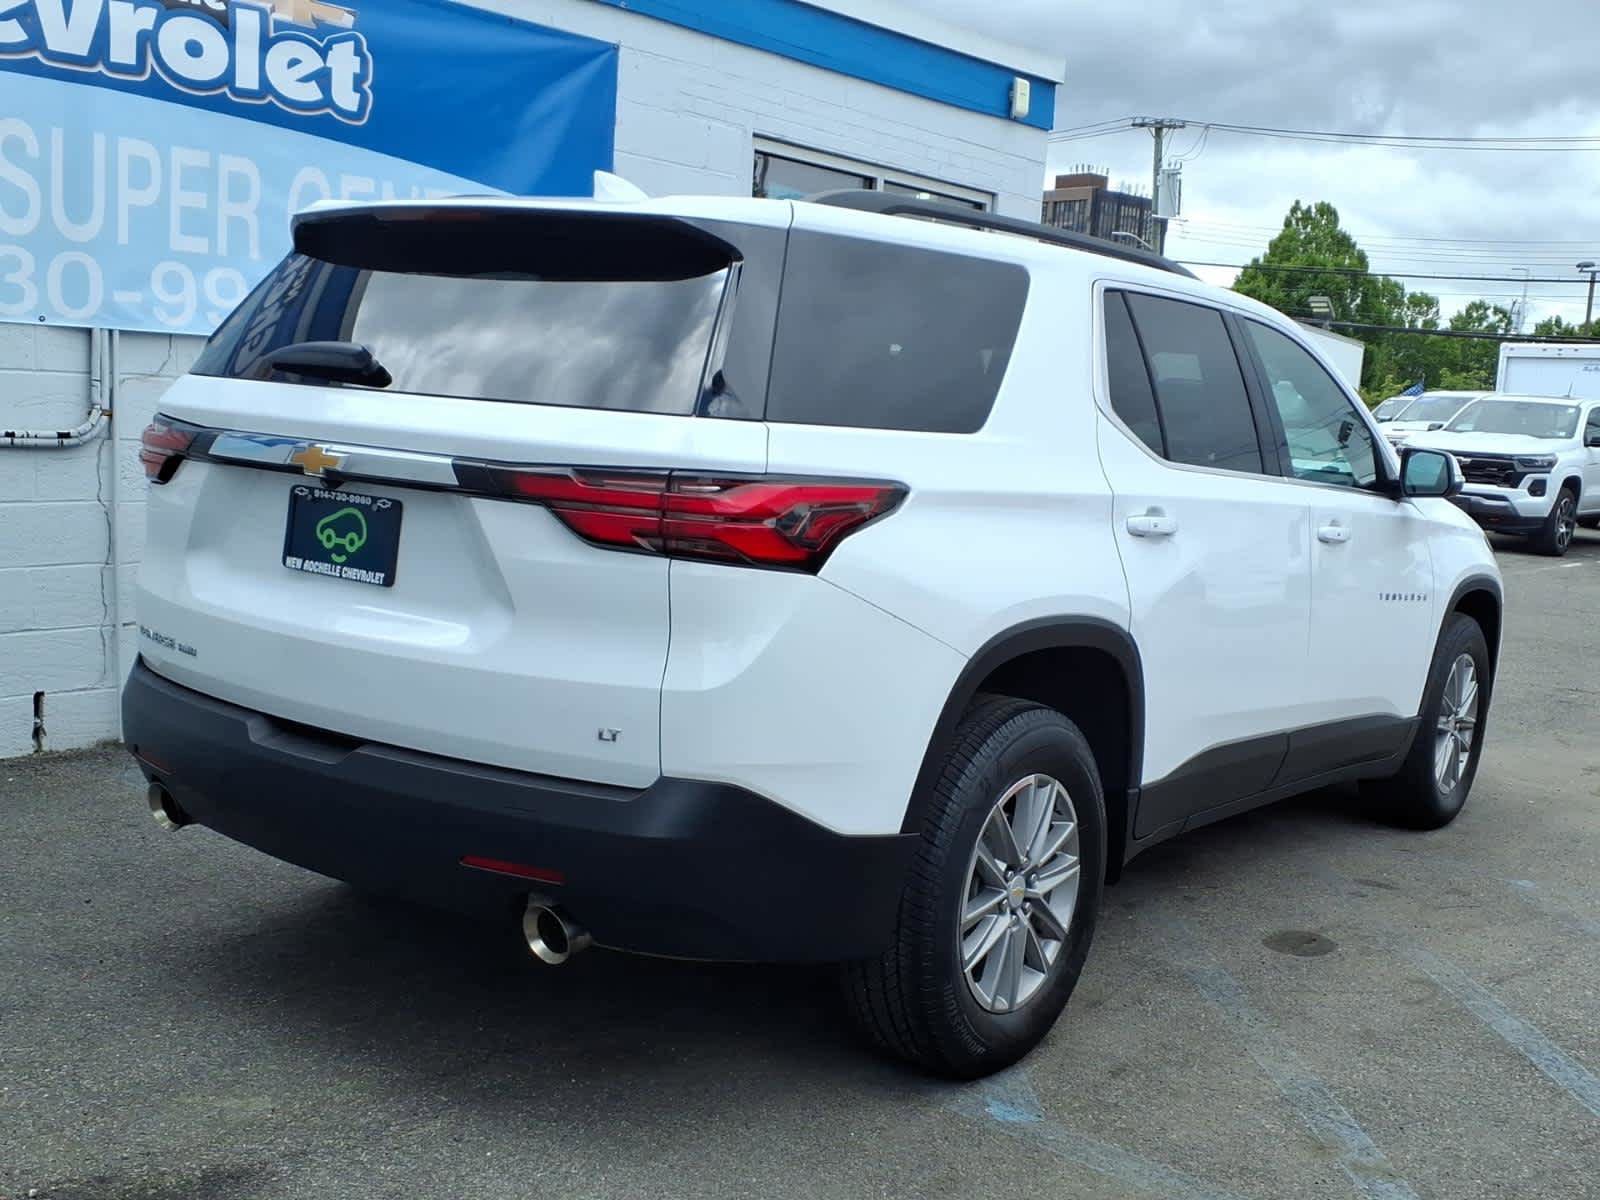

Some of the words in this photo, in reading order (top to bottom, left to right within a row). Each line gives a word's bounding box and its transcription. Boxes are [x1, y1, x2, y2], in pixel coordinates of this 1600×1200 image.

[0, 117, 261, 262] SUPER
[286, 556, 303, 569] NEW
[342, 567, 385, 584] CHEVROLET
[598, 728, 621, 742] LT
